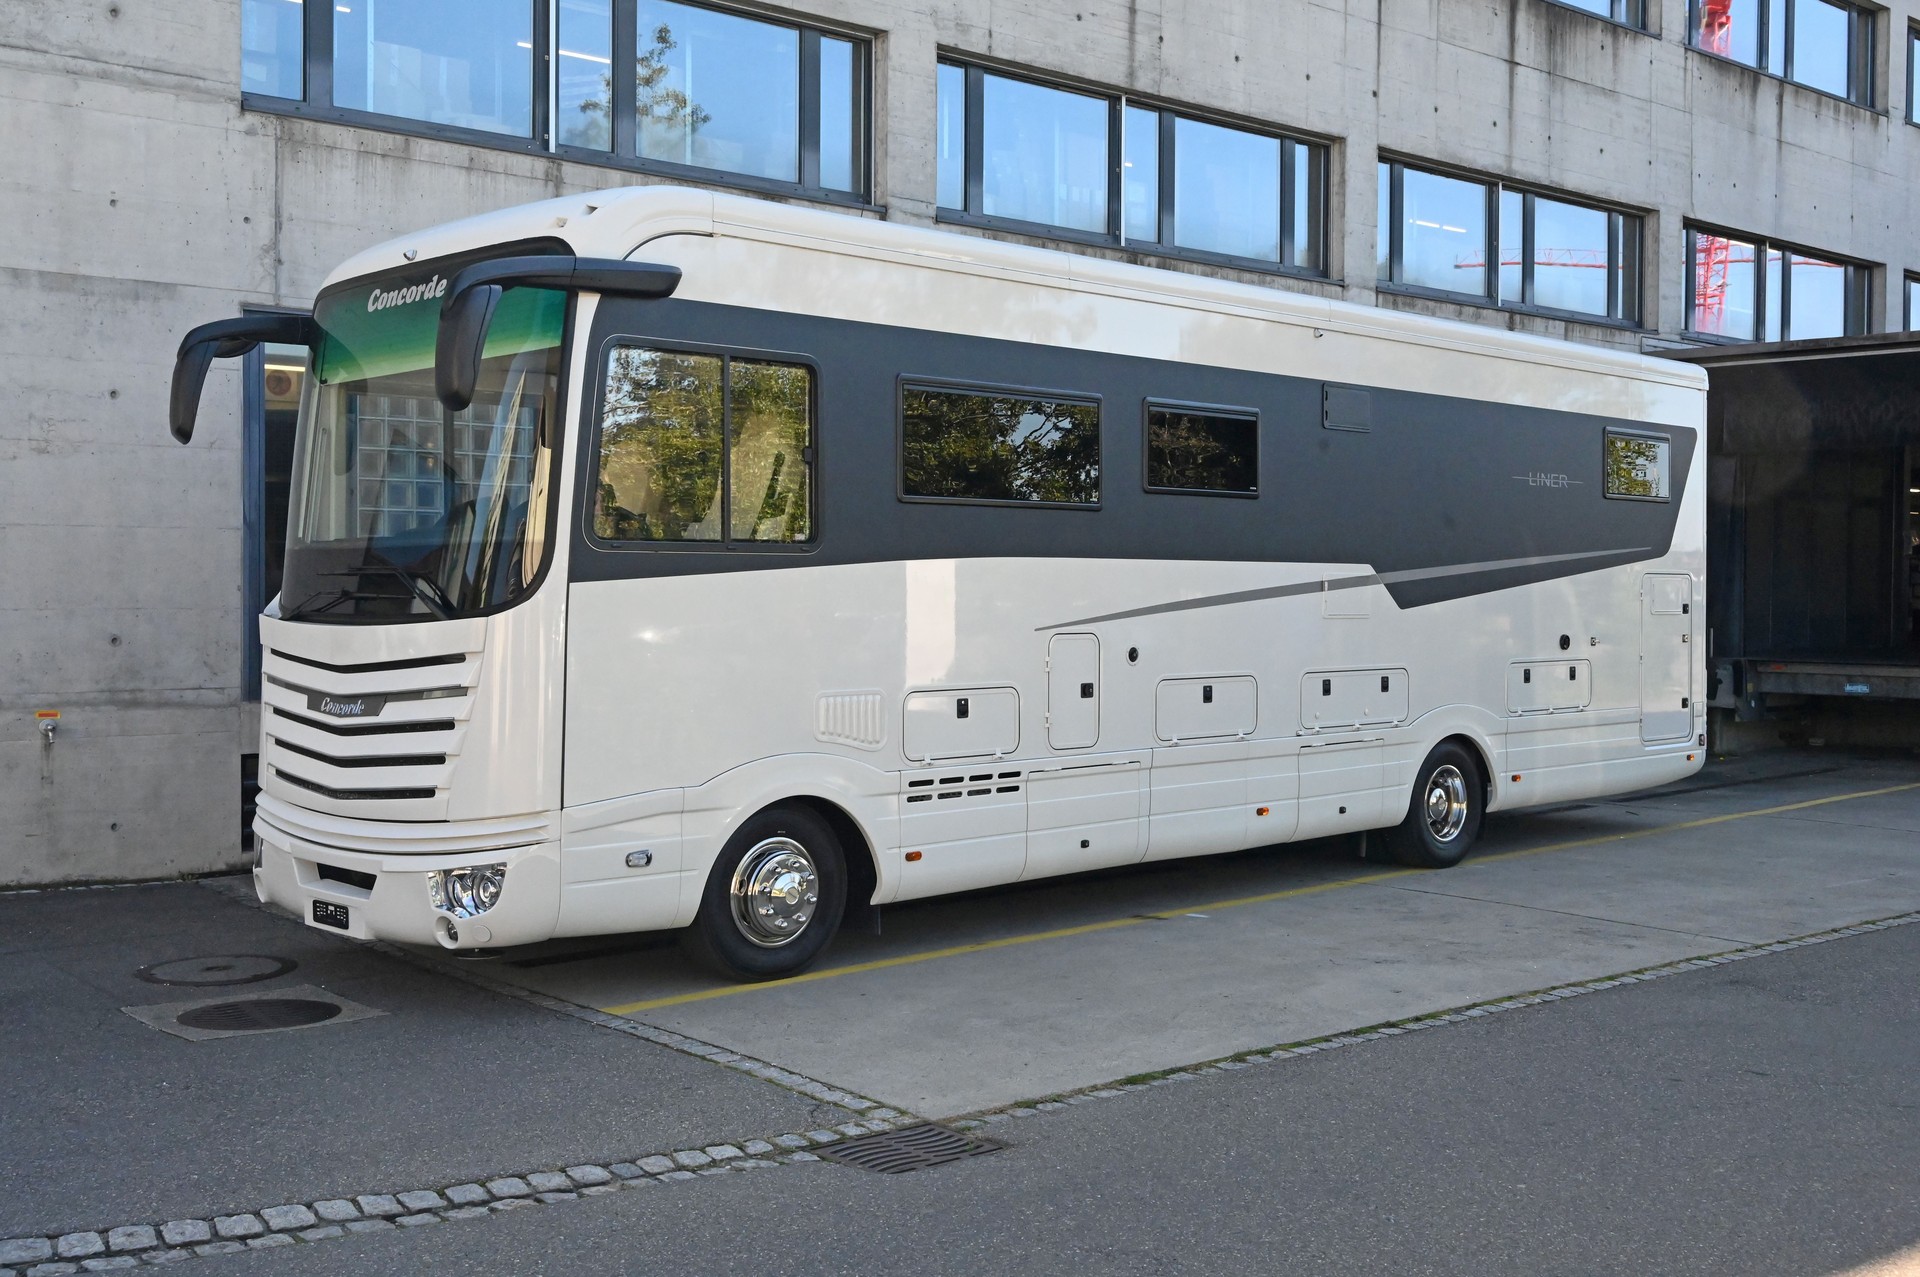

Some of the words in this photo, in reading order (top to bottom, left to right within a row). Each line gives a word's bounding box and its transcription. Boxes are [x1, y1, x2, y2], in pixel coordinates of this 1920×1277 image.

[367, 274, 447, 312] Concorde
[1529, 472, 1568, 488] LINER
[320, 697, 365, 715] Concorde
